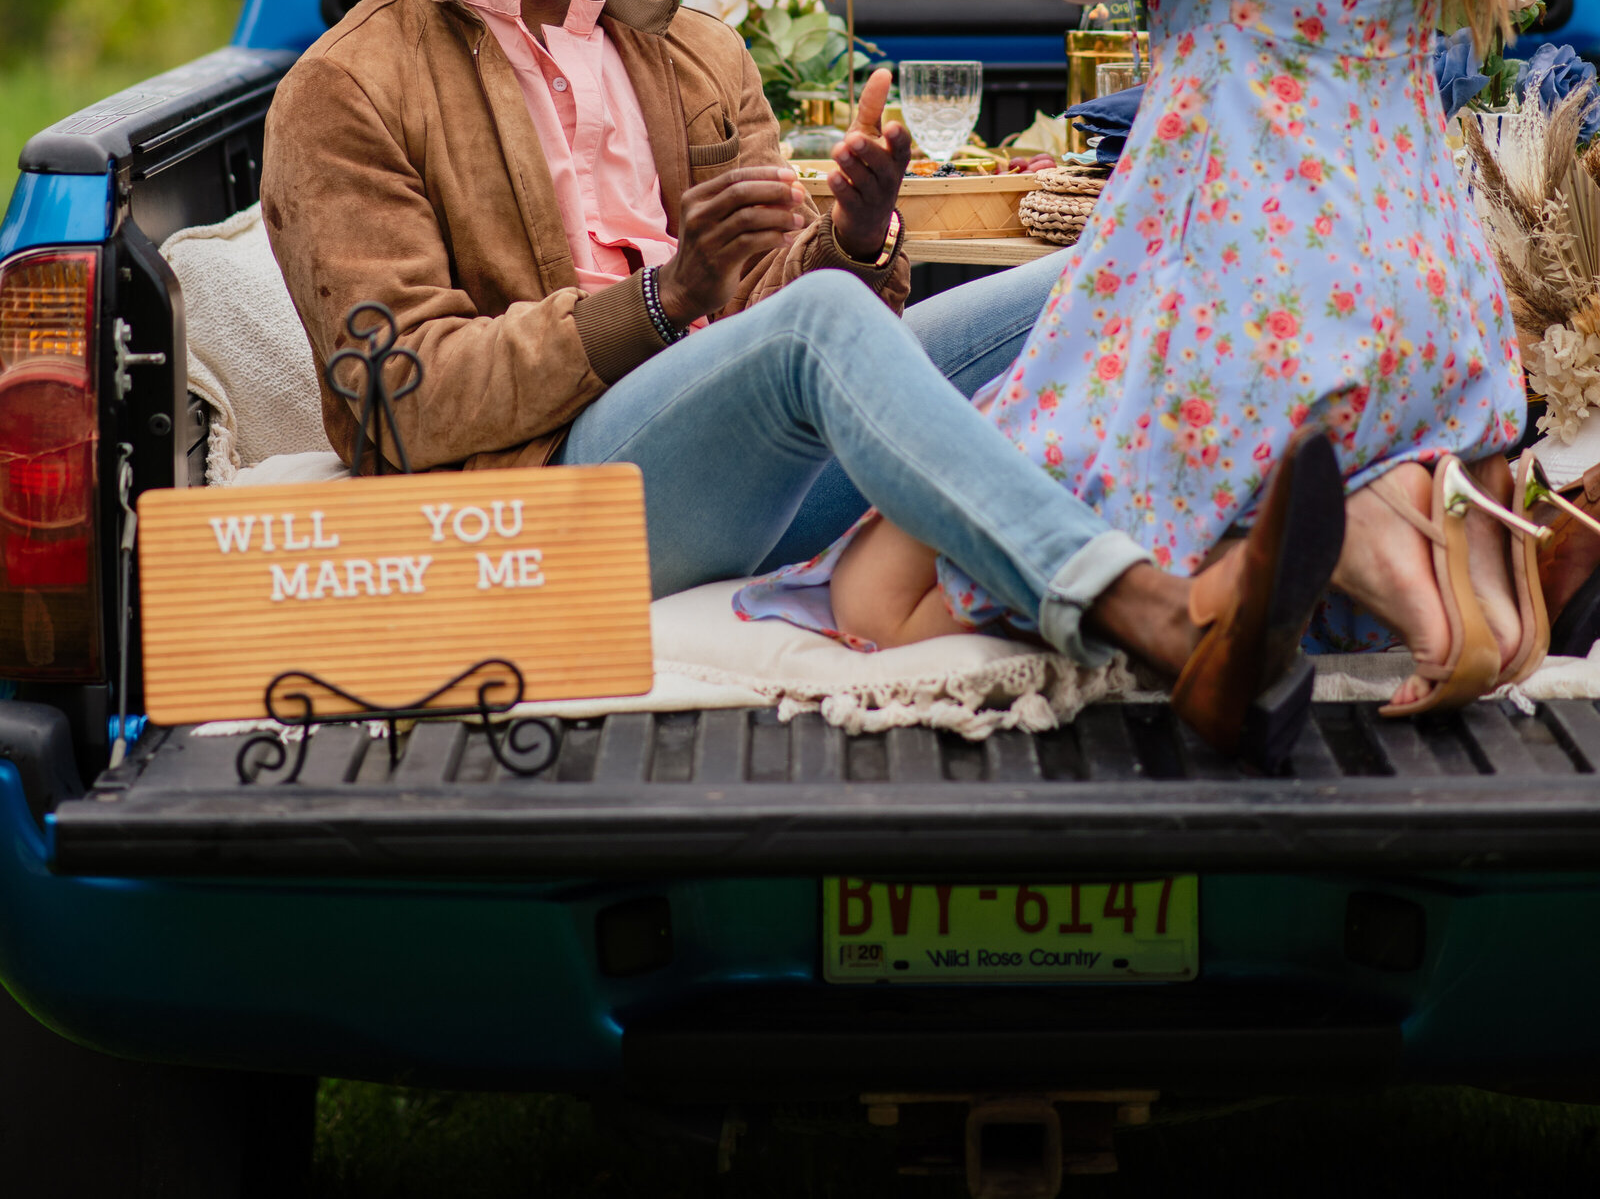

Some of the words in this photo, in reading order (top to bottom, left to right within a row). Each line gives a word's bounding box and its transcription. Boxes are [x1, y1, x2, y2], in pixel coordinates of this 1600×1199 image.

[209, 510, 340, 553] WILL
[420, 499, 525, 543] YOU
[269, 554, 433, 601] MARRY
[475, 548, 546, 590] ME
[838, 876, 1174, 936] BVY-6147
[858, 945, 880, 960] 20
[925, 948, 969, 968] Wild
[977, 949, 1023, 967] Rose
[1029, 948, 1101, 969] Country
